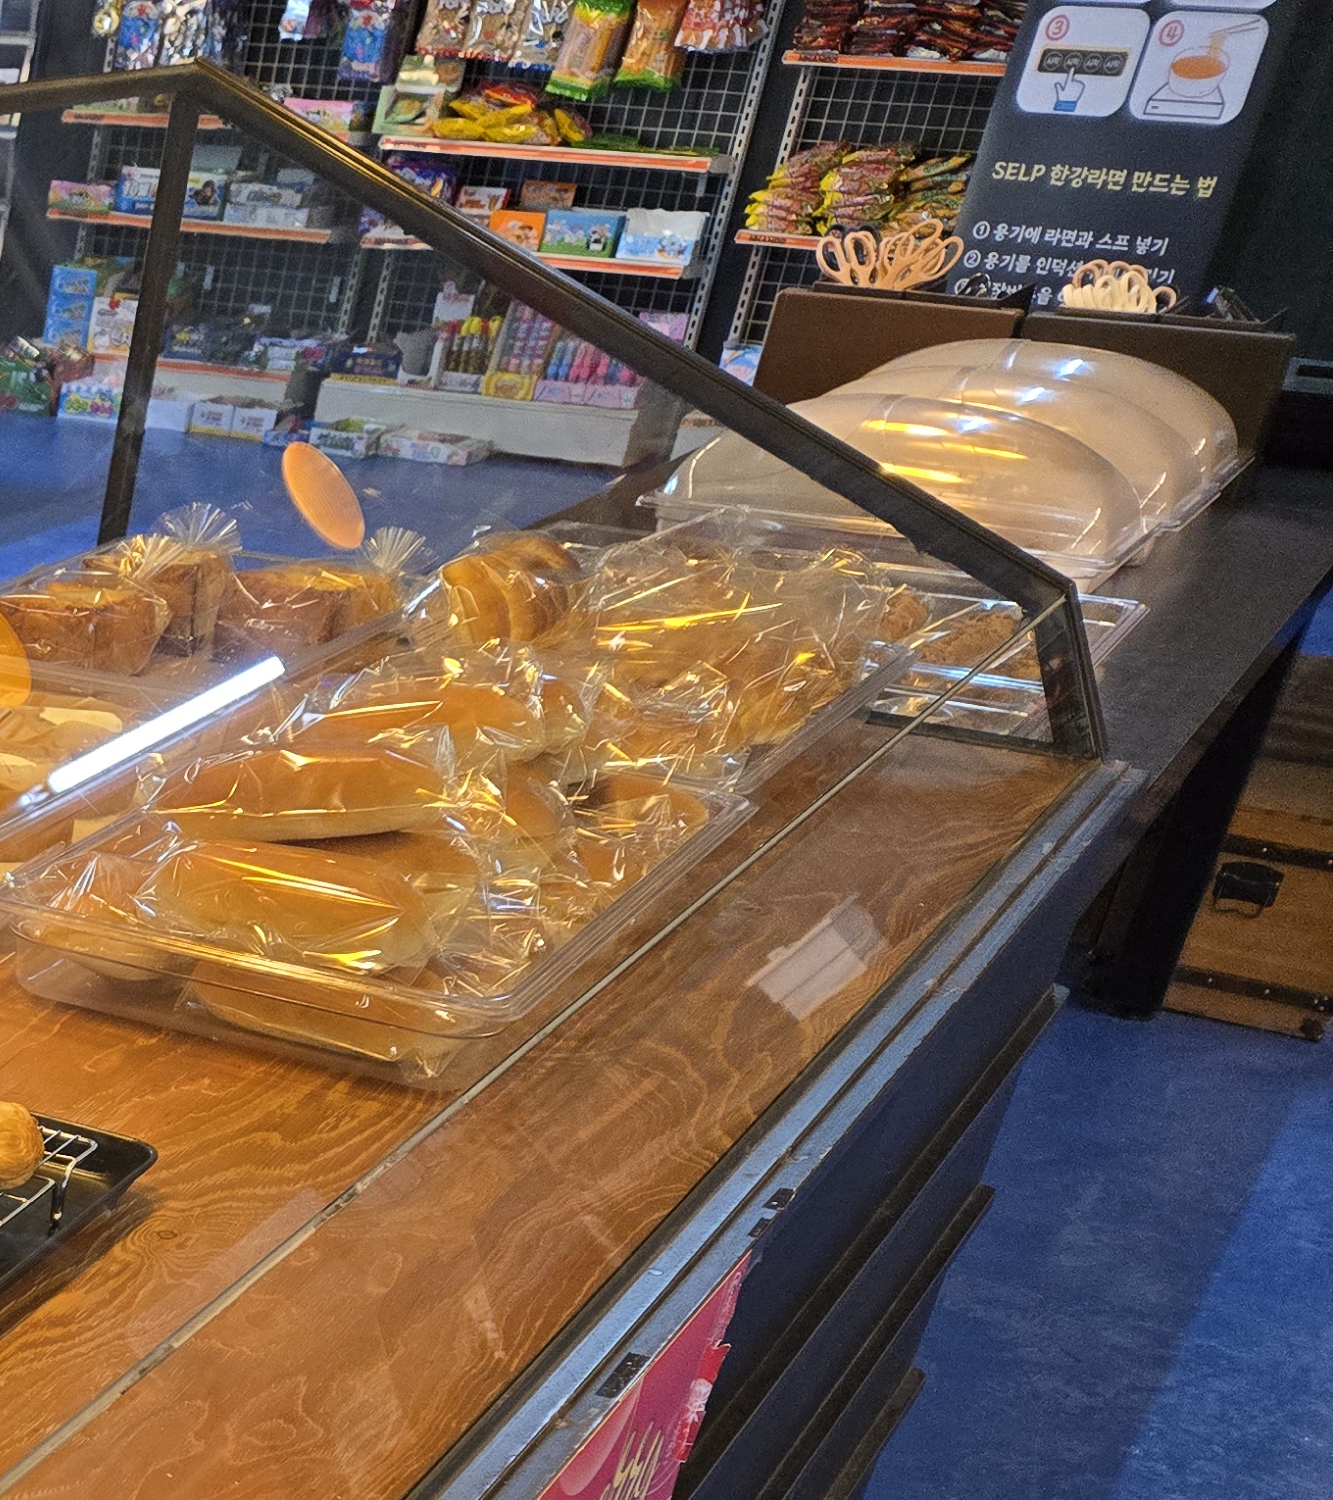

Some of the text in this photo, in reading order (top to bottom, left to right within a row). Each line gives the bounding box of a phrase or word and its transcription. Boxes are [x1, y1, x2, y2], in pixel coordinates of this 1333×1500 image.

[992, 161, 1218, 198] SELP 한강라면 만드는 법
[993, 222, 1041, 243] 용기에
[1043, 228, 1093, 250] 라면과
[1096, 233, 1130, 251] 스프
[1135, 235, 1169, 256] 넣기
[983, 252, 1031, 275] 용기를
